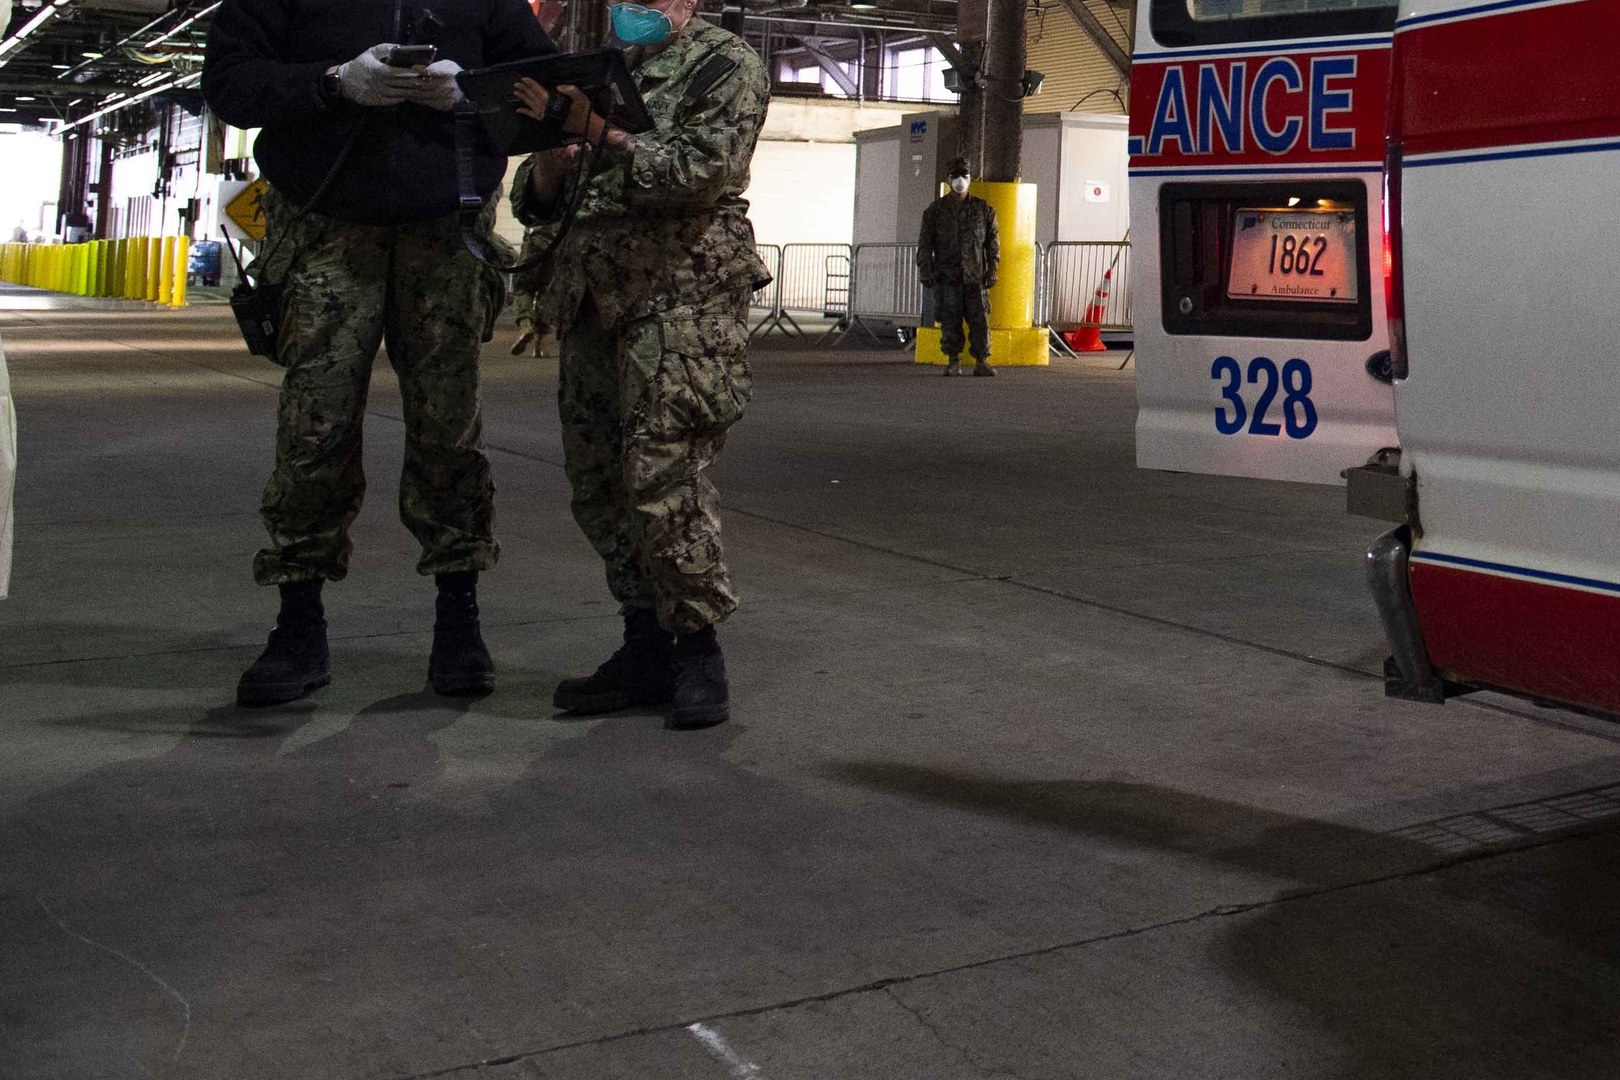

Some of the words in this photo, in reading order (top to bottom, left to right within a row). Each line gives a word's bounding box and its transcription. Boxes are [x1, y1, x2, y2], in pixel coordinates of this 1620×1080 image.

[1128, 55, 1358, 156] ANCE
[910, 120, 928, 136] NYC
[1271, 216, 1331, 231] Connecticut
[1268, 233, 1328, 277] 1862
[1270, 284, 1320, 296] Ambulance
[1211, 356, 1318, 440] 328
